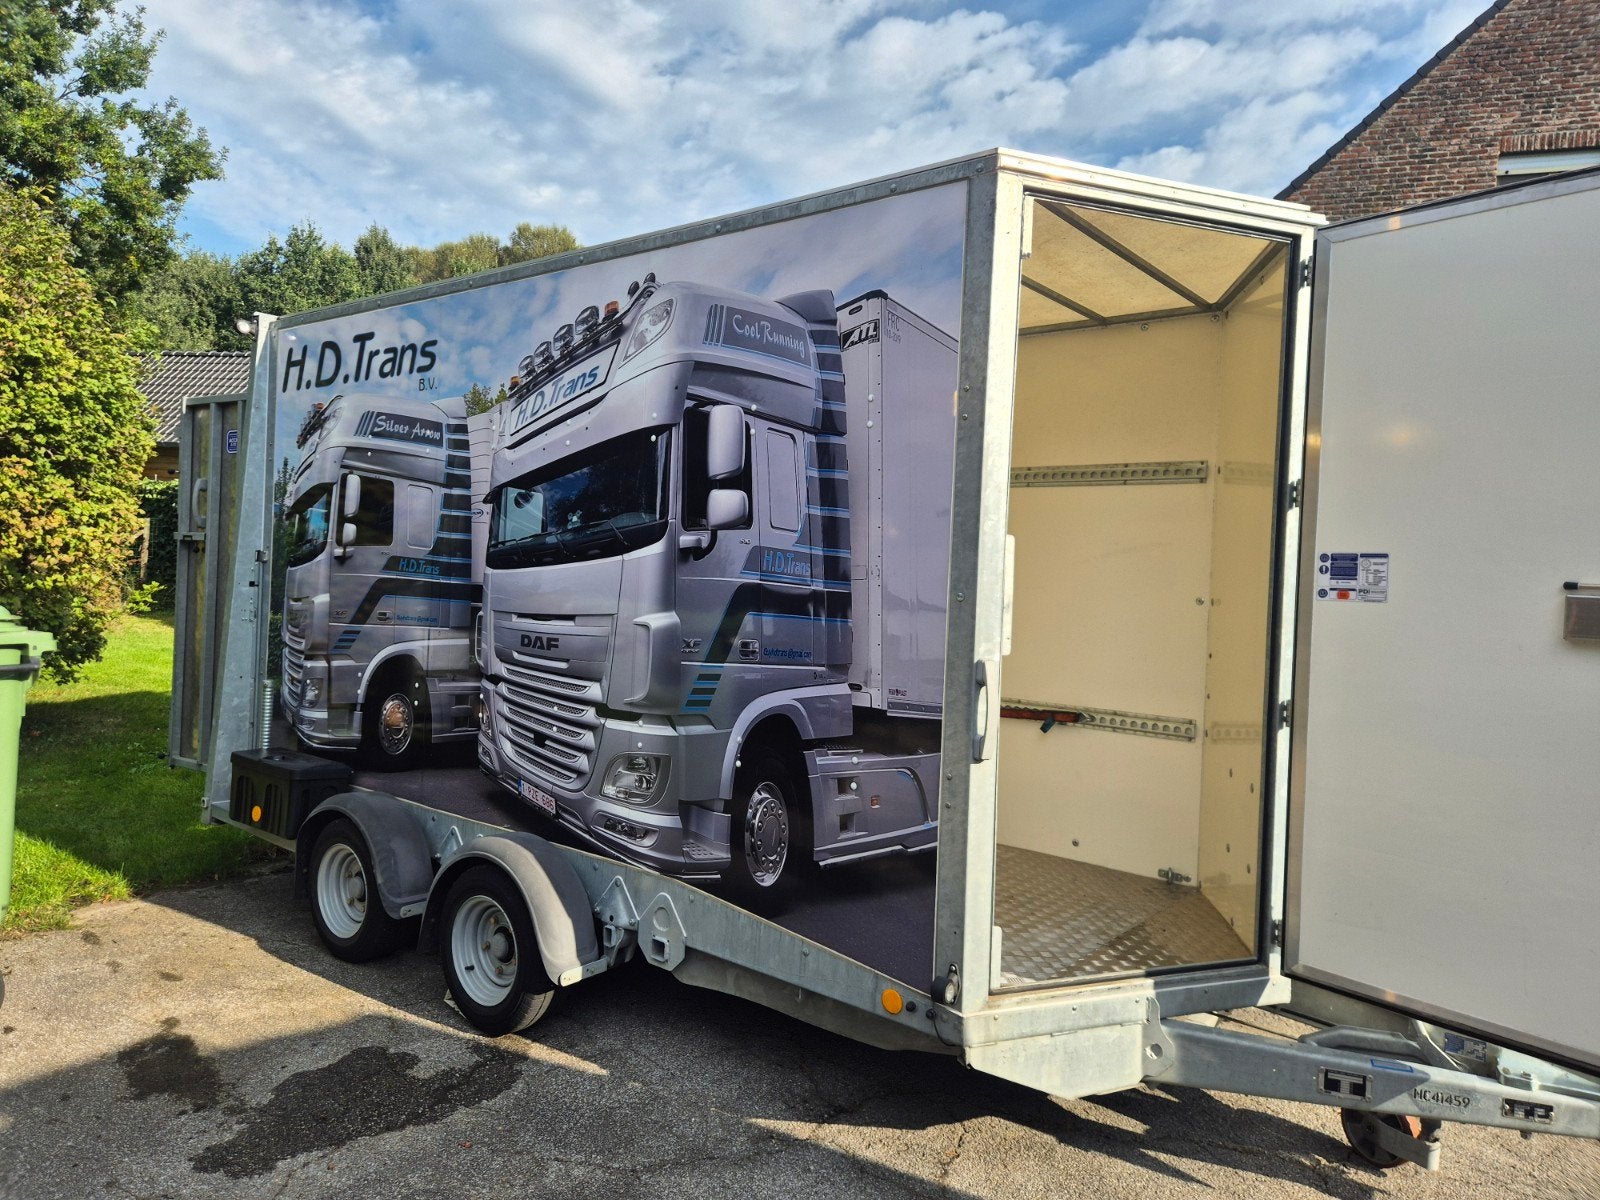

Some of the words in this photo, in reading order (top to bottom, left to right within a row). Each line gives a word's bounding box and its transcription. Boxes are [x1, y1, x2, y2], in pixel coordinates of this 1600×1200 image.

[732, 314, 761, 338] Cool
[760, 321, 805, 358] Running
[843, 322, 877, 349] ATL
[282, 331, 438, 393] H.D.Trans
[418, 377, 438, 392] B.V.
[373, 415, 409, 435] Silver
[411, 421, 441, 440] Arrow
[521, 634, 560, 651] DAF
